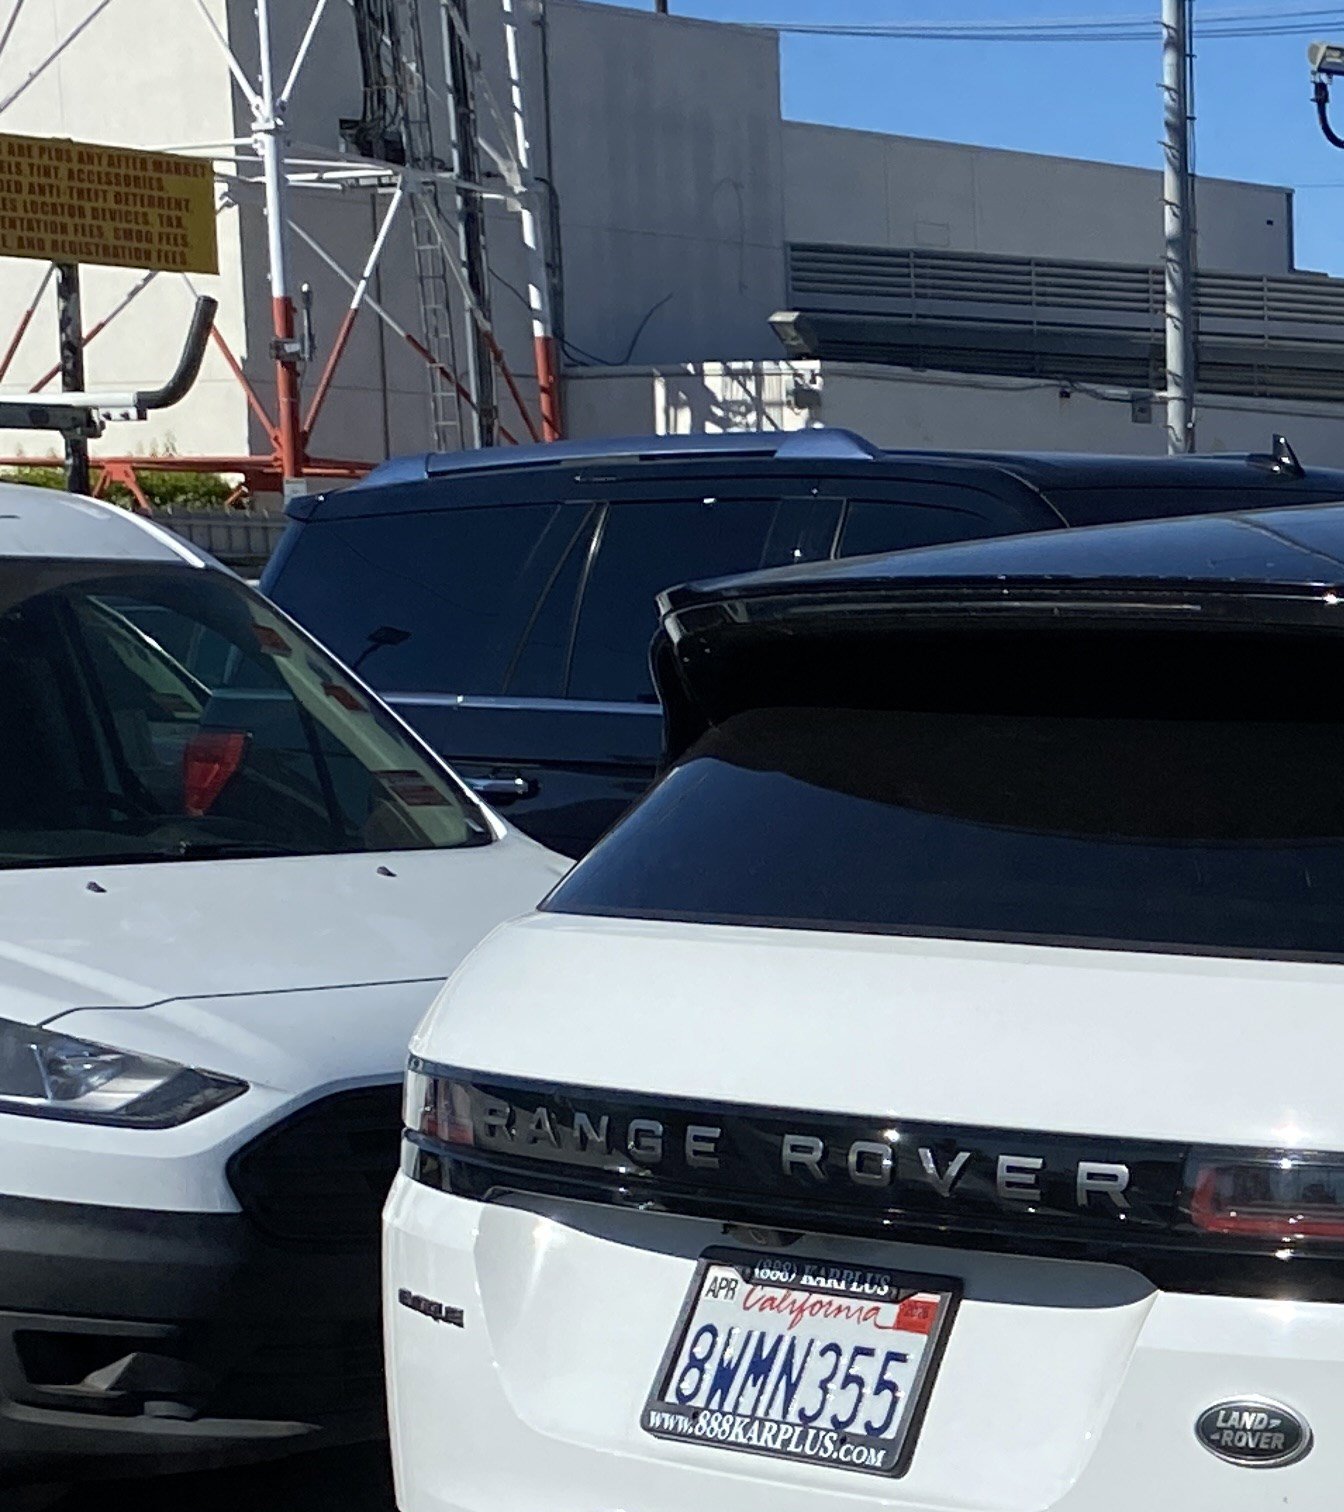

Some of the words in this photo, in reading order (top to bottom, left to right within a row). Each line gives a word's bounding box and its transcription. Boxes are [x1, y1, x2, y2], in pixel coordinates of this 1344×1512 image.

[482, 1096, 722, 1168] RANGE
[780, 1134, 1136, 1210] ROVER
[705, 1275, 738, 1299] APR
[799, 1264, 892, 1297] KARPLUS
[742, 1284, 895, 1330] California
[675, 1324, 909, 1438] 8WMN355
[1216, 1410, 1268, 1431] LAND
[1221, 1430, 1285, 1450] ROVER
